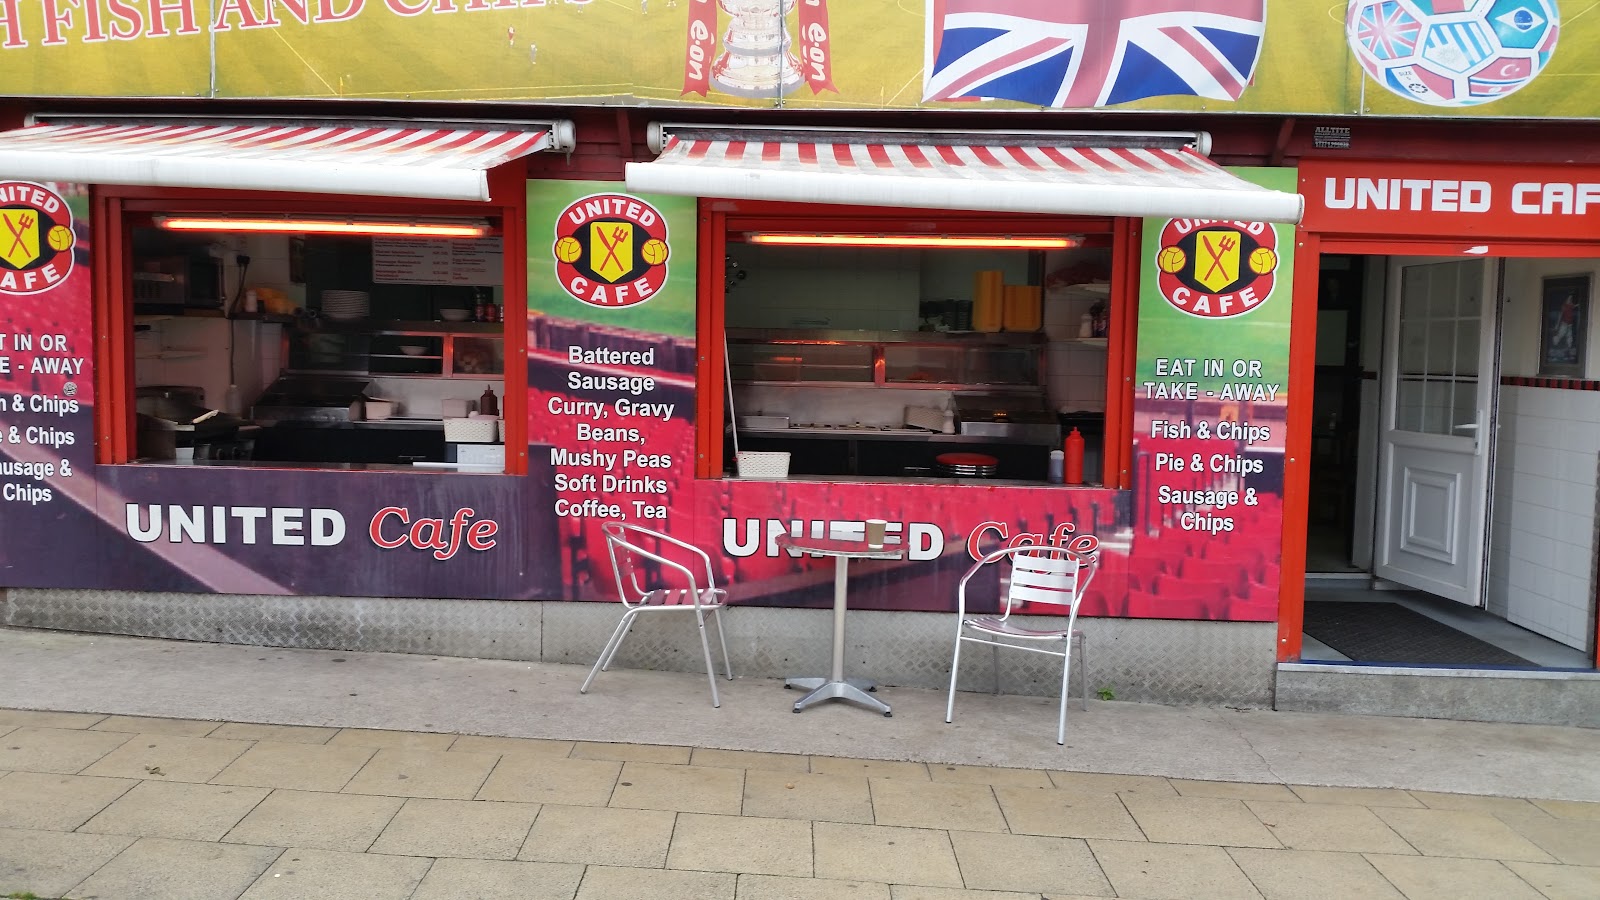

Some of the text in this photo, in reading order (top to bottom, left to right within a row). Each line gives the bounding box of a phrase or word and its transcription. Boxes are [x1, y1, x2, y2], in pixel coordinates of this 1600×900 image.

[42, 0, 200, 47] FISH
[1325, 178, 1492, 213] UNITED
[568, 199, 656, 227] UNITED
[570, 277, 653, 304] CAFE
[1172, 287, 1259, 313] CAFE
[14, 333, 32, 351] IN
[40, 334, 68, 352] OR
[31, 357, 84, 375] AWAY
[568, 345, 655, 365] Battered
[1155, 358, 1262, 378] EAT IN OR
[567, 371, 655, 395] Sausage
[1143, 382, 1198, 400] TAKE
[1220, 384, 1280, 401] AWAY
[12, 393, 26, 412] &
[29, 394, 79, 417] Chips
[547, 396, 675, 422] Curry, Gravy
[8, 425, 21, 444] &
[26, 426, 75, 448] Chips
[577, 423, 645, 445] Beans,
[1151, 420, 1270, 444] Fish & Chips
[59, 459, 73, 477] &
[550, 448, 672, 471] Mushy Peas
[1155, 453, 1264, 477] Pie & Chips
[3, 483, 52, 505] Chips
[554, 473, 667, 493] Soft Drinks
[1158, 485, 1258, 509] Sausage &
[554, 499, 667, 521] Coffee, Tea
[125, 503, 499, 560] UNITED Cafe
[1180, 512, 1234, 535] Chips
